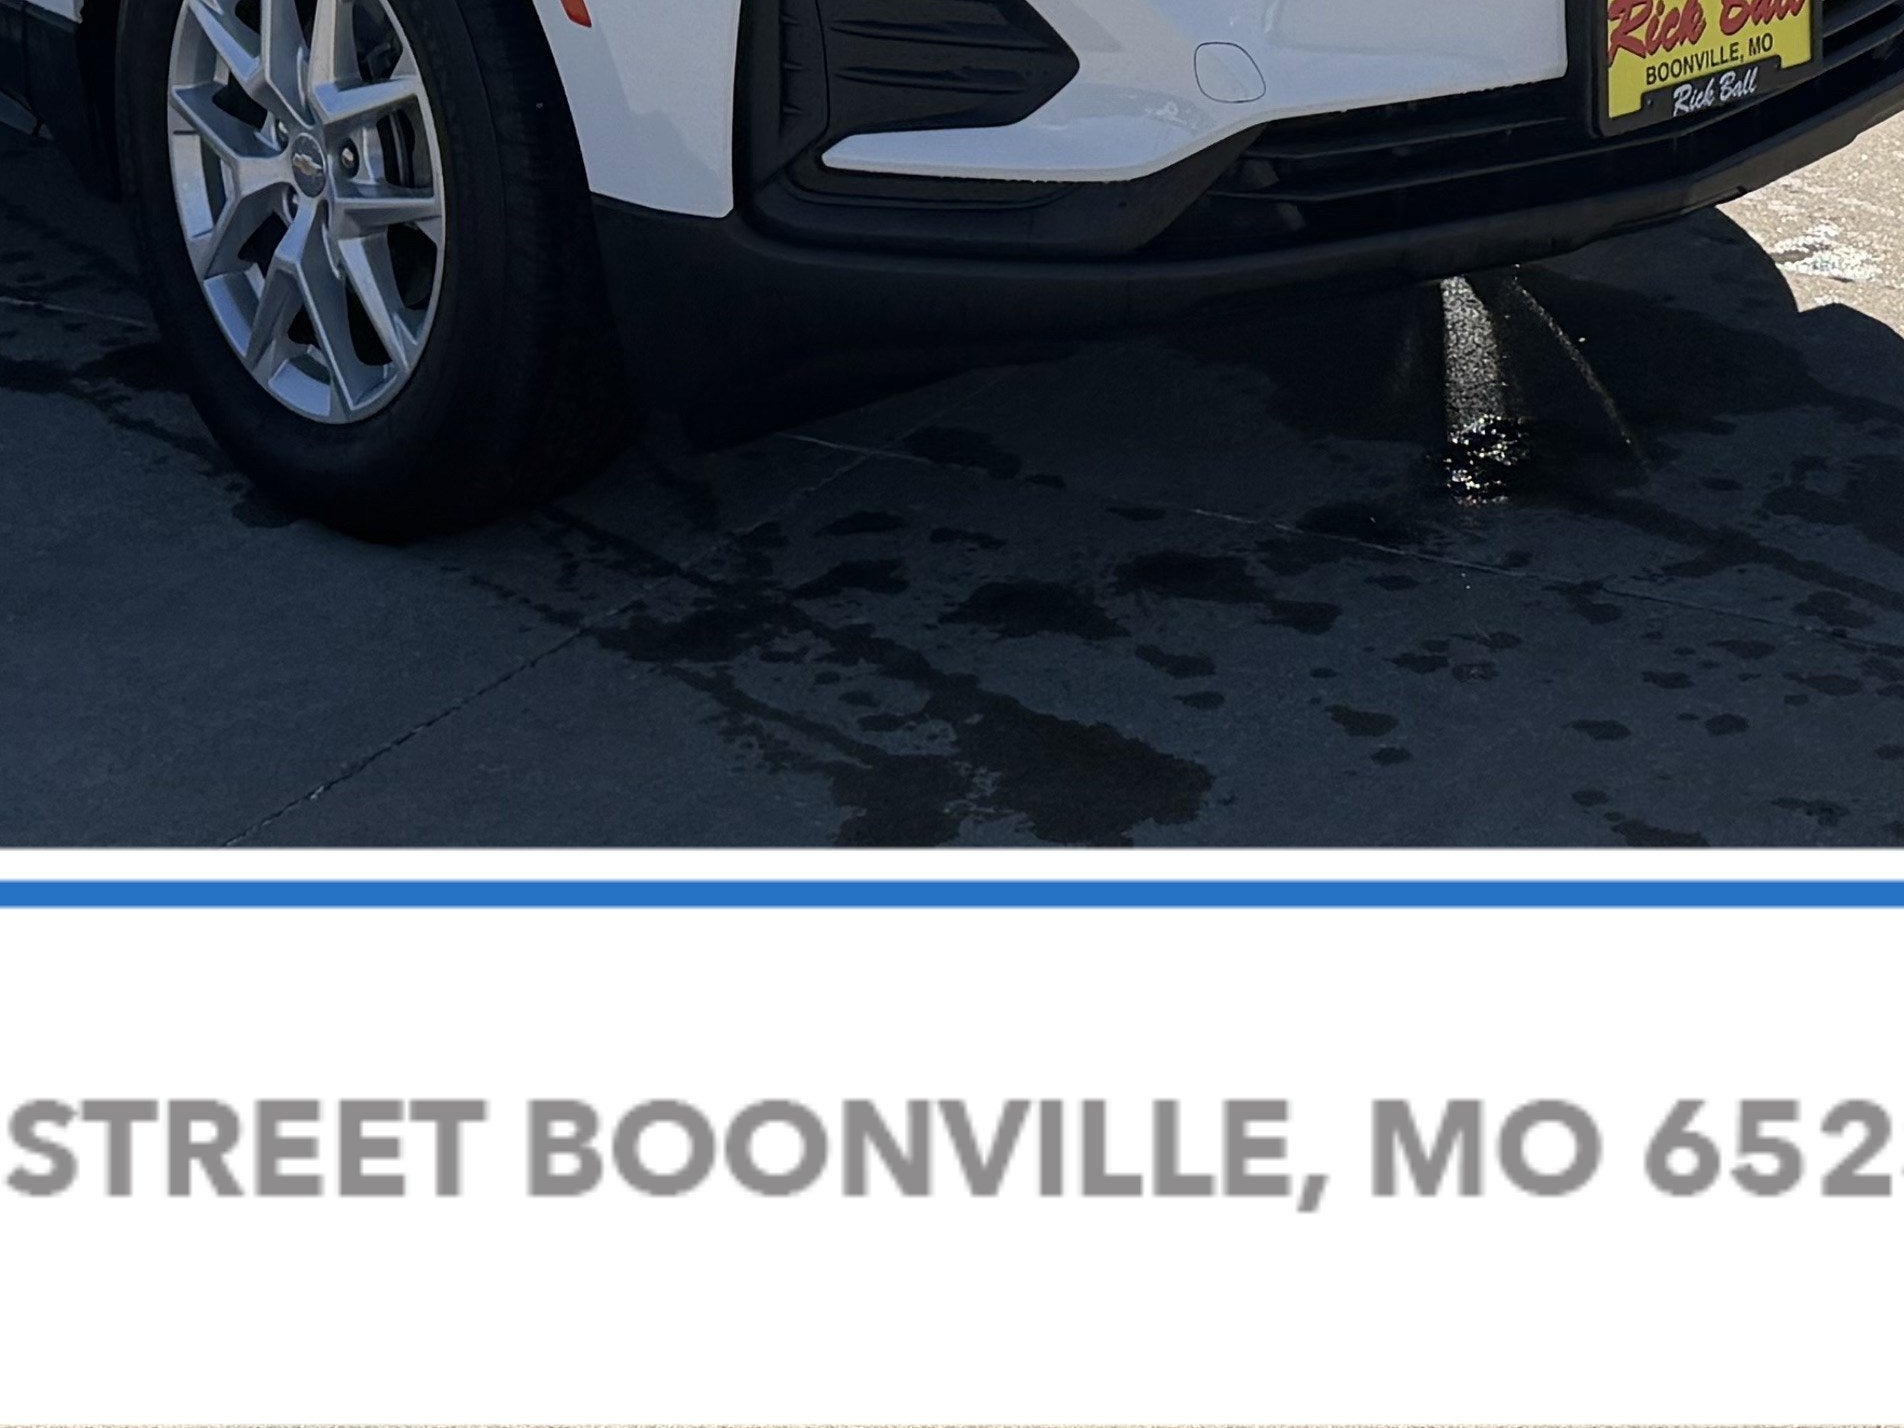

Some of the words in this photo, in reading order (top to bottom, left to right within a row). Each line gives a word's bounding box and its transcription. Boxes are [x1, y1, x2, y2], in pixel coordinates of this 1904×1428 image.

[1646, 41, 1745, 85] BOONVILLE,
[1748, 32, 1774, 57] MO
[1672, 77, 1716, 118] Rick
[1719, 66, 1759, 102] Ball
